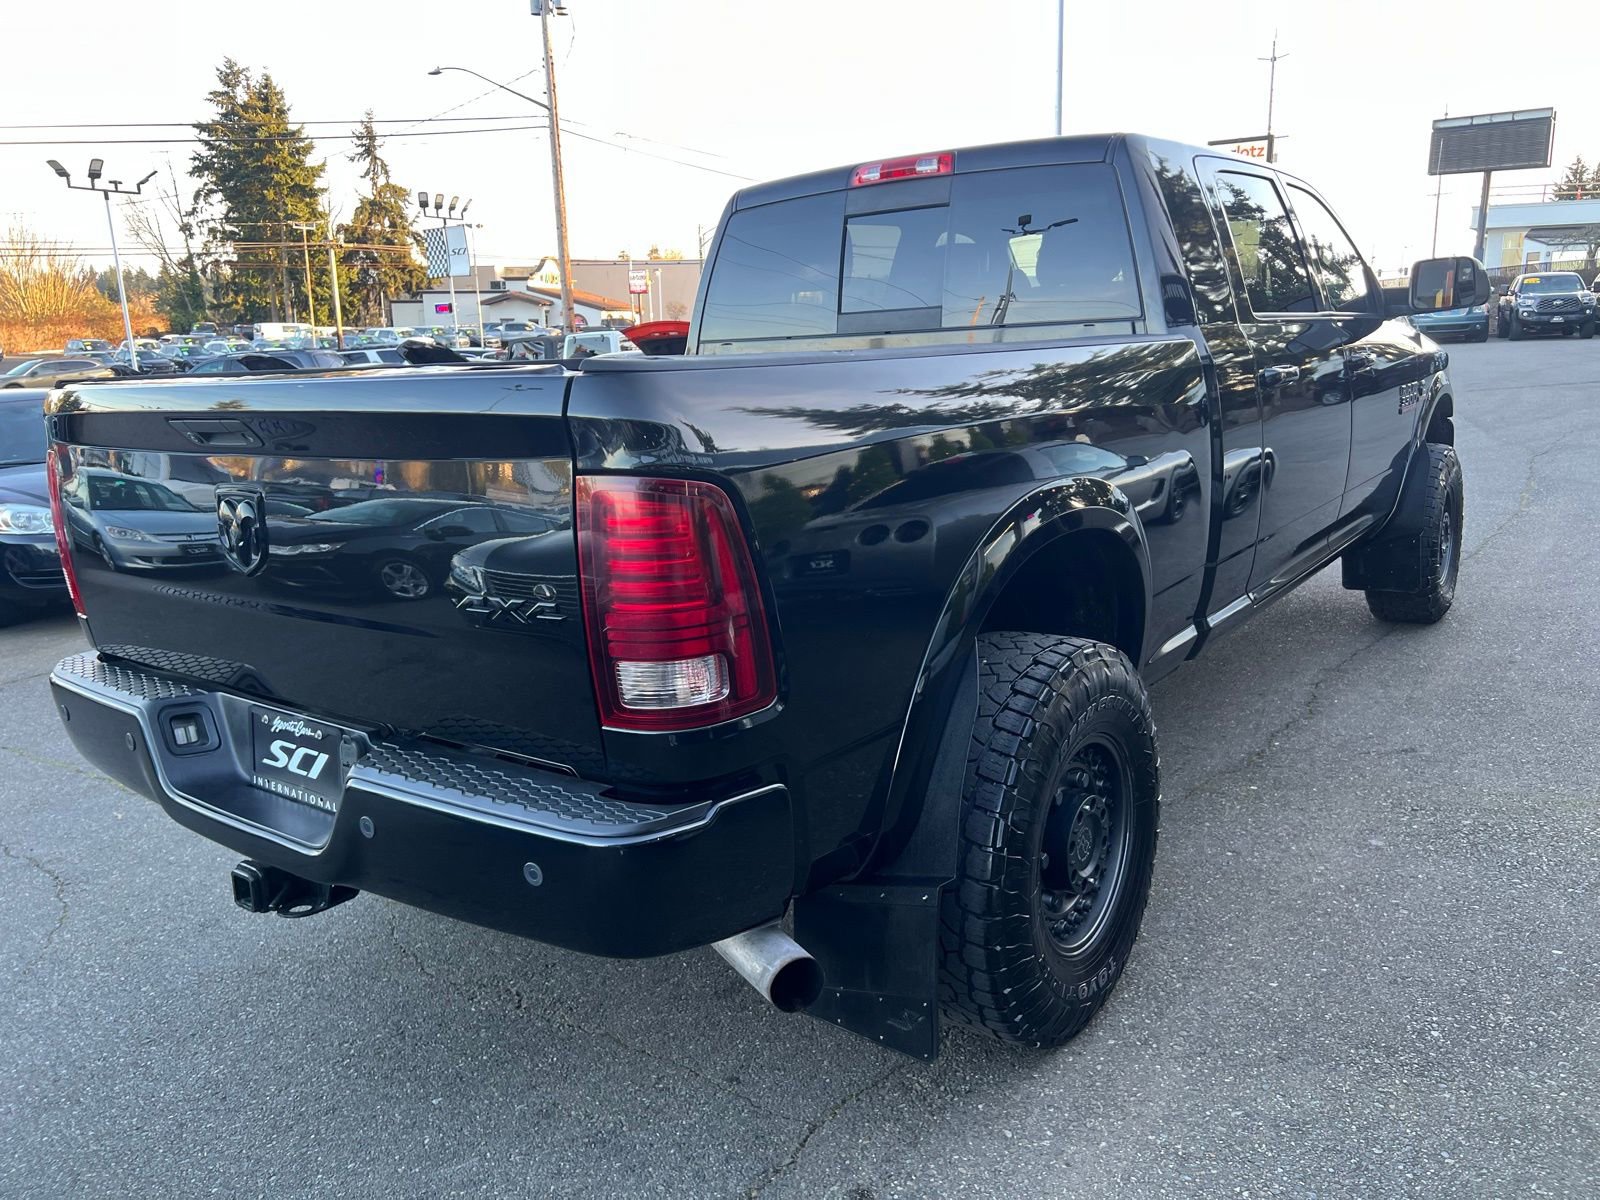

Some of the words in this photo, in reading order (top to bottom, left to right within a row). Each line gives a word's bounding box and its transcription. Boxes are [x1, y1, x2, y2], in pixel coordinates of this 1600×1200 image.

[1231, 145, 1265, 158] lotz
[450, 247, 467, 256] SCI
[262, 739, 330, 780] SCI
[253, 775, 337, 812] INTERNATIONAL
